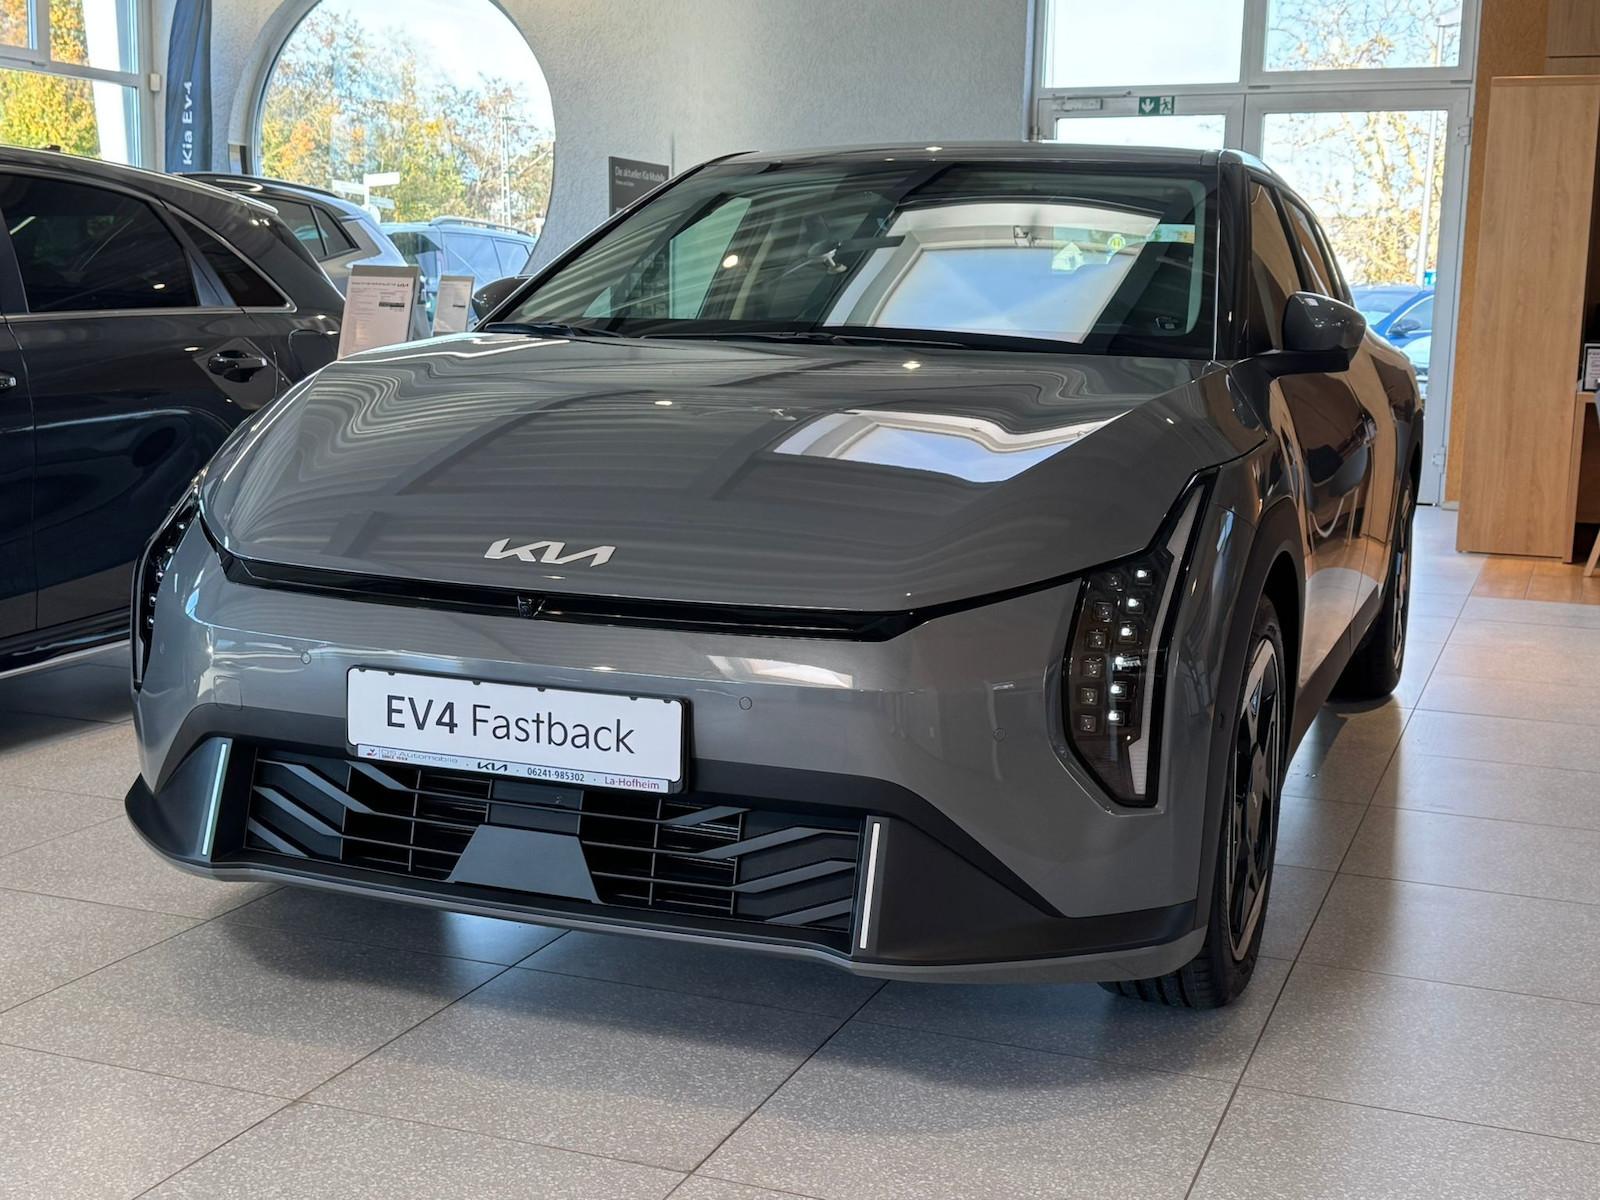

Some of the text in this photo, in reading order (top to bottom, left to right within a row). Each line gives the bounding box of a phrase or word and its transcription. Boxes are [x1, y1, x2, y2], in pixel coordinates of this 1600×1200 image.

[182, 130, 193, 166] Kia
[484, 537, 617, 567] KIA
[386, 694, 635, 754] EV4 Fastback
[477, 761, 508, 772] KIA
[527, 767, 585, 782] 06241-985302
[604, 775, 660, 790] La-Hofheim
